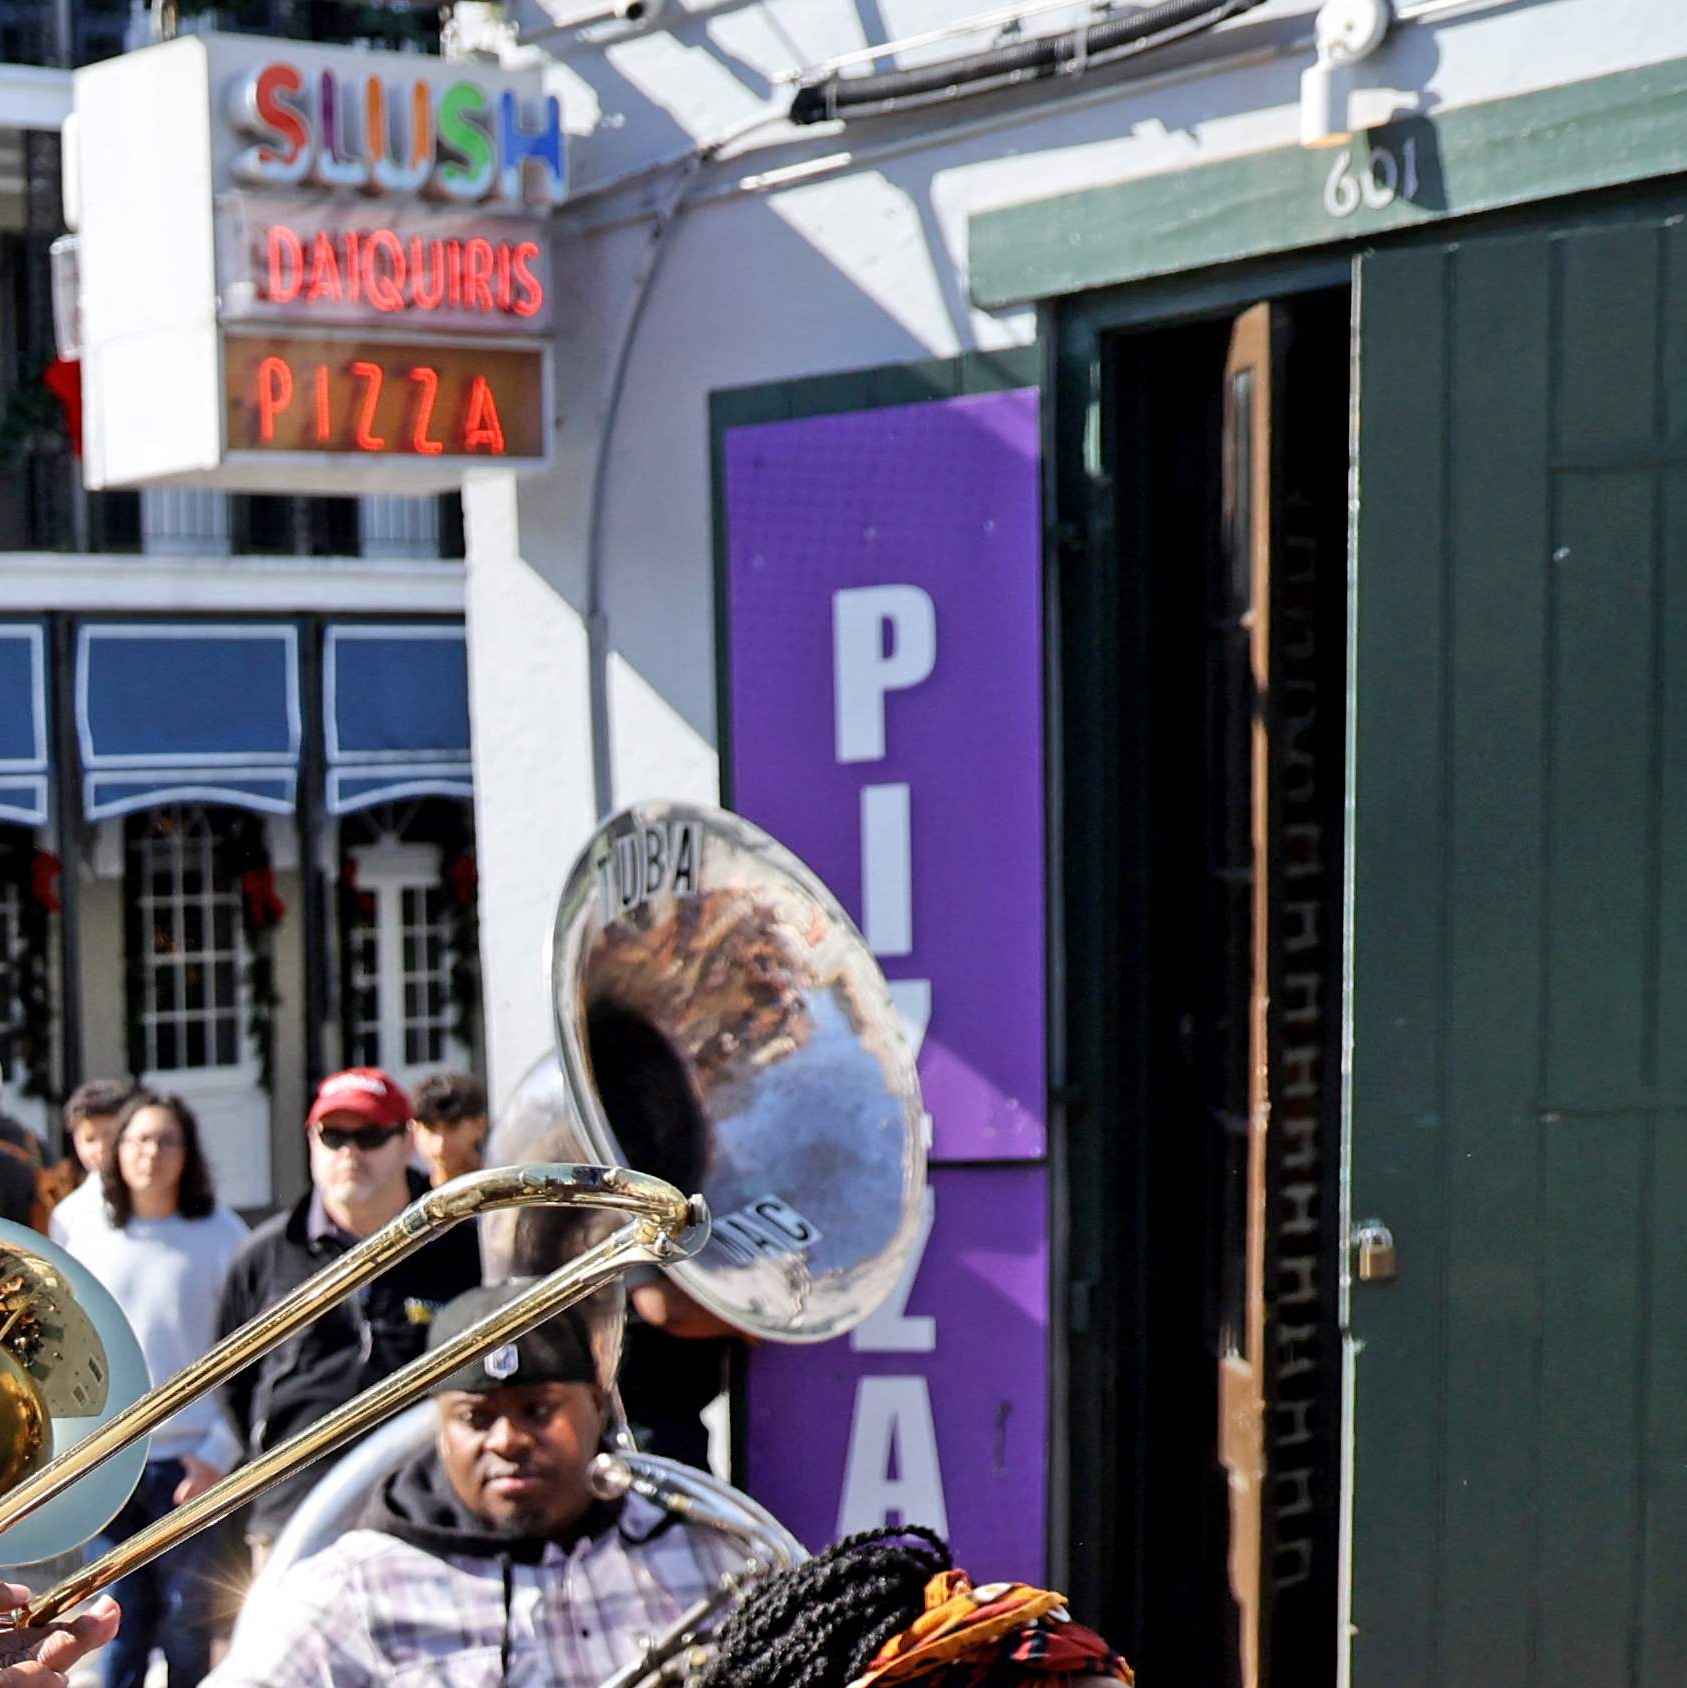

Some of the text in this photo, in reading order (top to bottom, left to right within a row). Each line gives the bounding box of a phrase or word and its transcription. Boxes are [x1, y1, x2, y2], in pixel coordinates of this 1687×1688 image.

[247, 60, 567, 204] SLUSH
[1324, 137, 1418, 218] 601
[267, 224, 544, 317] DAIQUIRIS
[257, 355, 505, 455] PIZZA
[597, 826, 695, 921] TUBA
[831, 583, 949, 1540] PIA
